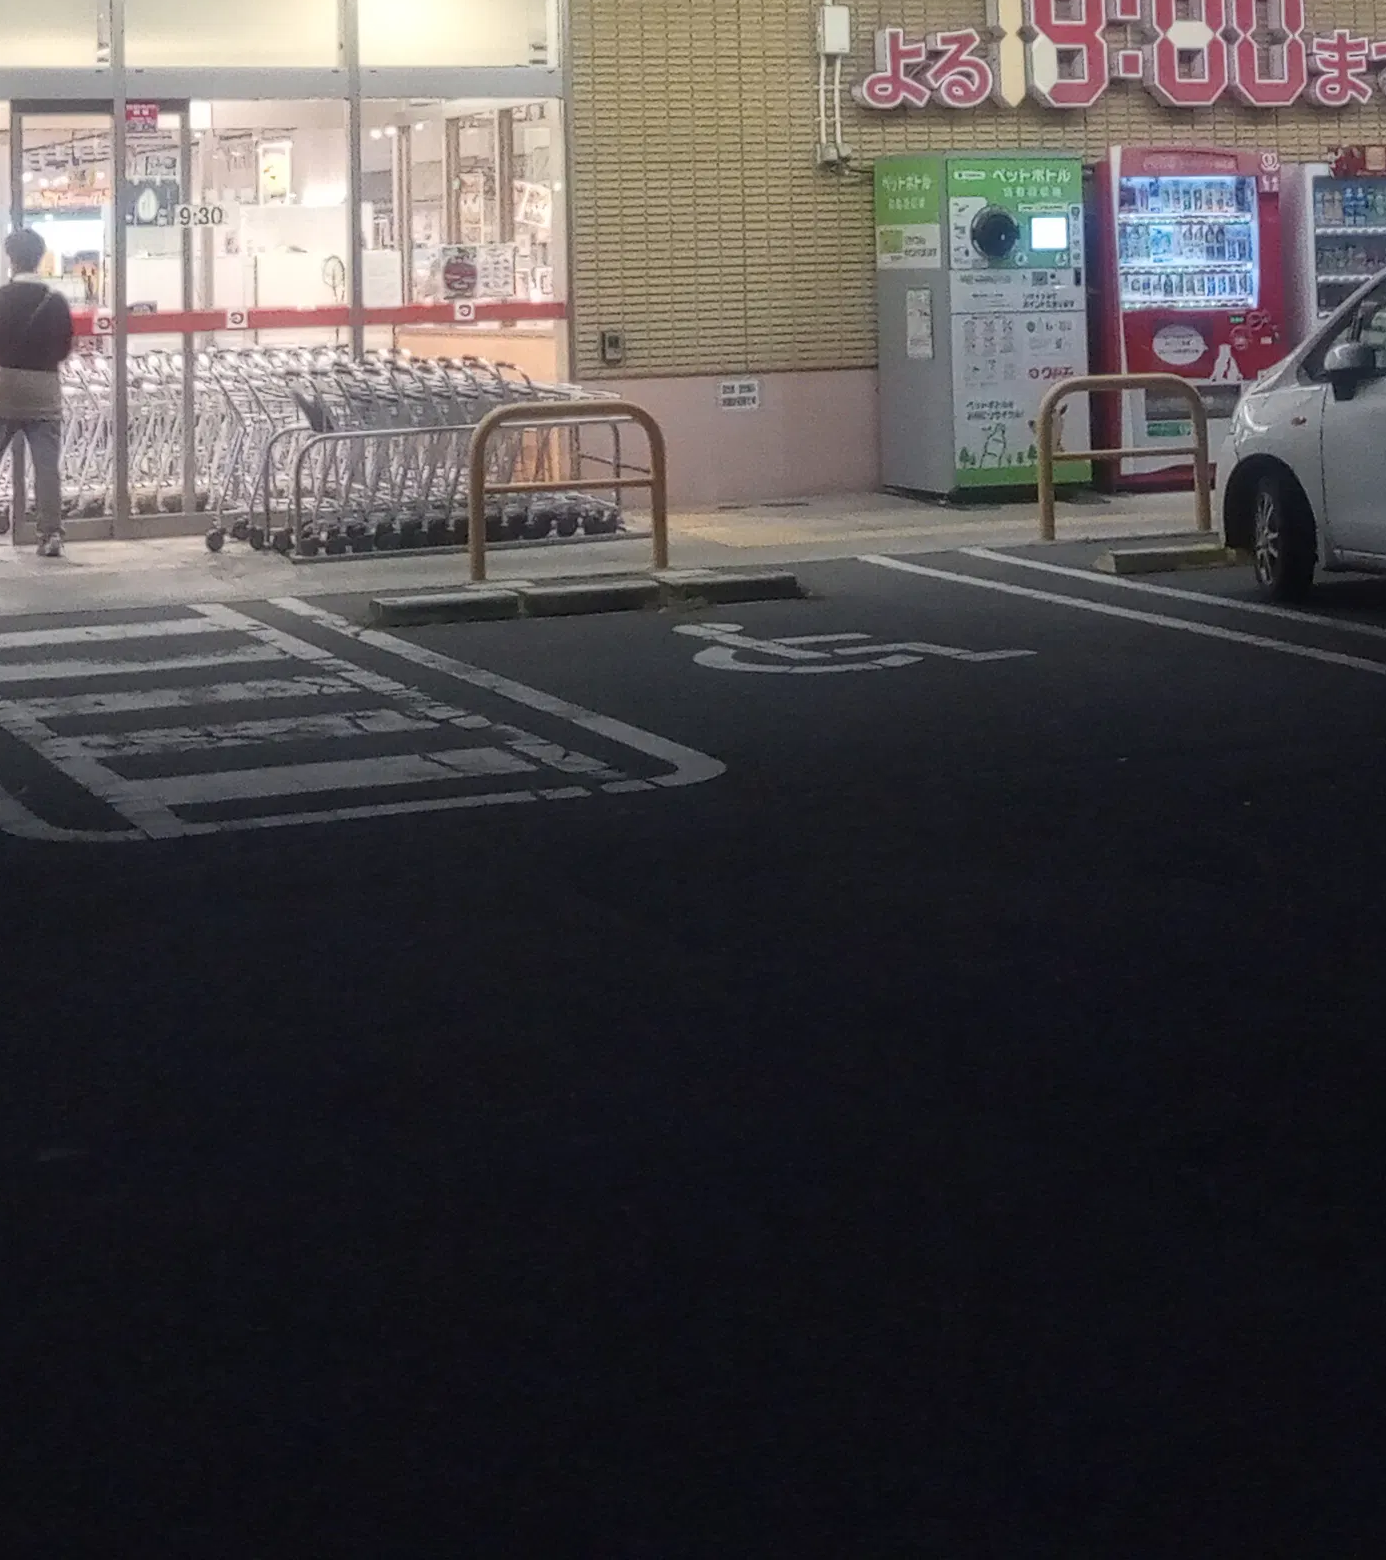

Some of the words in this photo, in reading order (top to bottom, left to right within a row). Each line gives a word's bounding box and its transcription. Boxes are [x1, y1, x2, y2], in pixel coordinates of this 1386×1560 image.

[992, 168, 1071, 183] ペットボトル
[179, 206, 223, 226] 9:30
